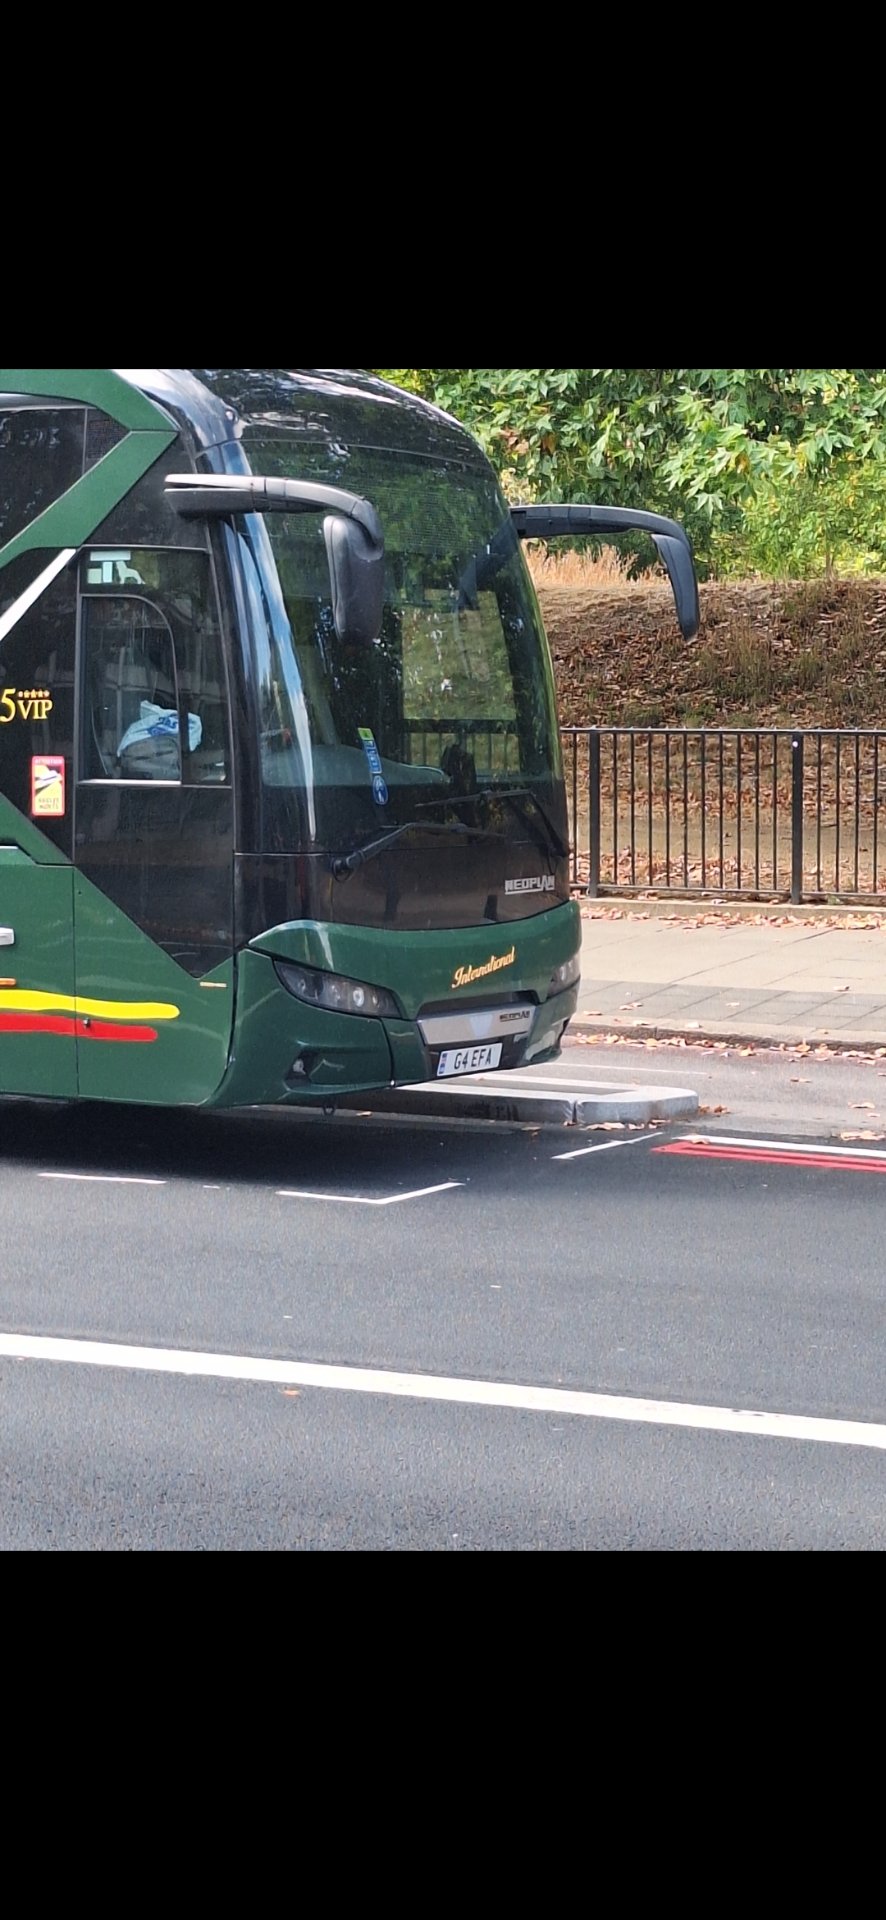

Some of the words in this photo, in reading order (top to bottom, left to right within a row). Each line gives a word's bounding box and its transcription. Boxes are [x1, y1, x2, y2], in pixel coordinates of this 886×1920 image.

[504, 874, 555, 895] NEOPLAN
[451, 945, 515, 989] International
[454, 1051, 469, 1070] G4
[471, 1048, 492, 1067] EFA
